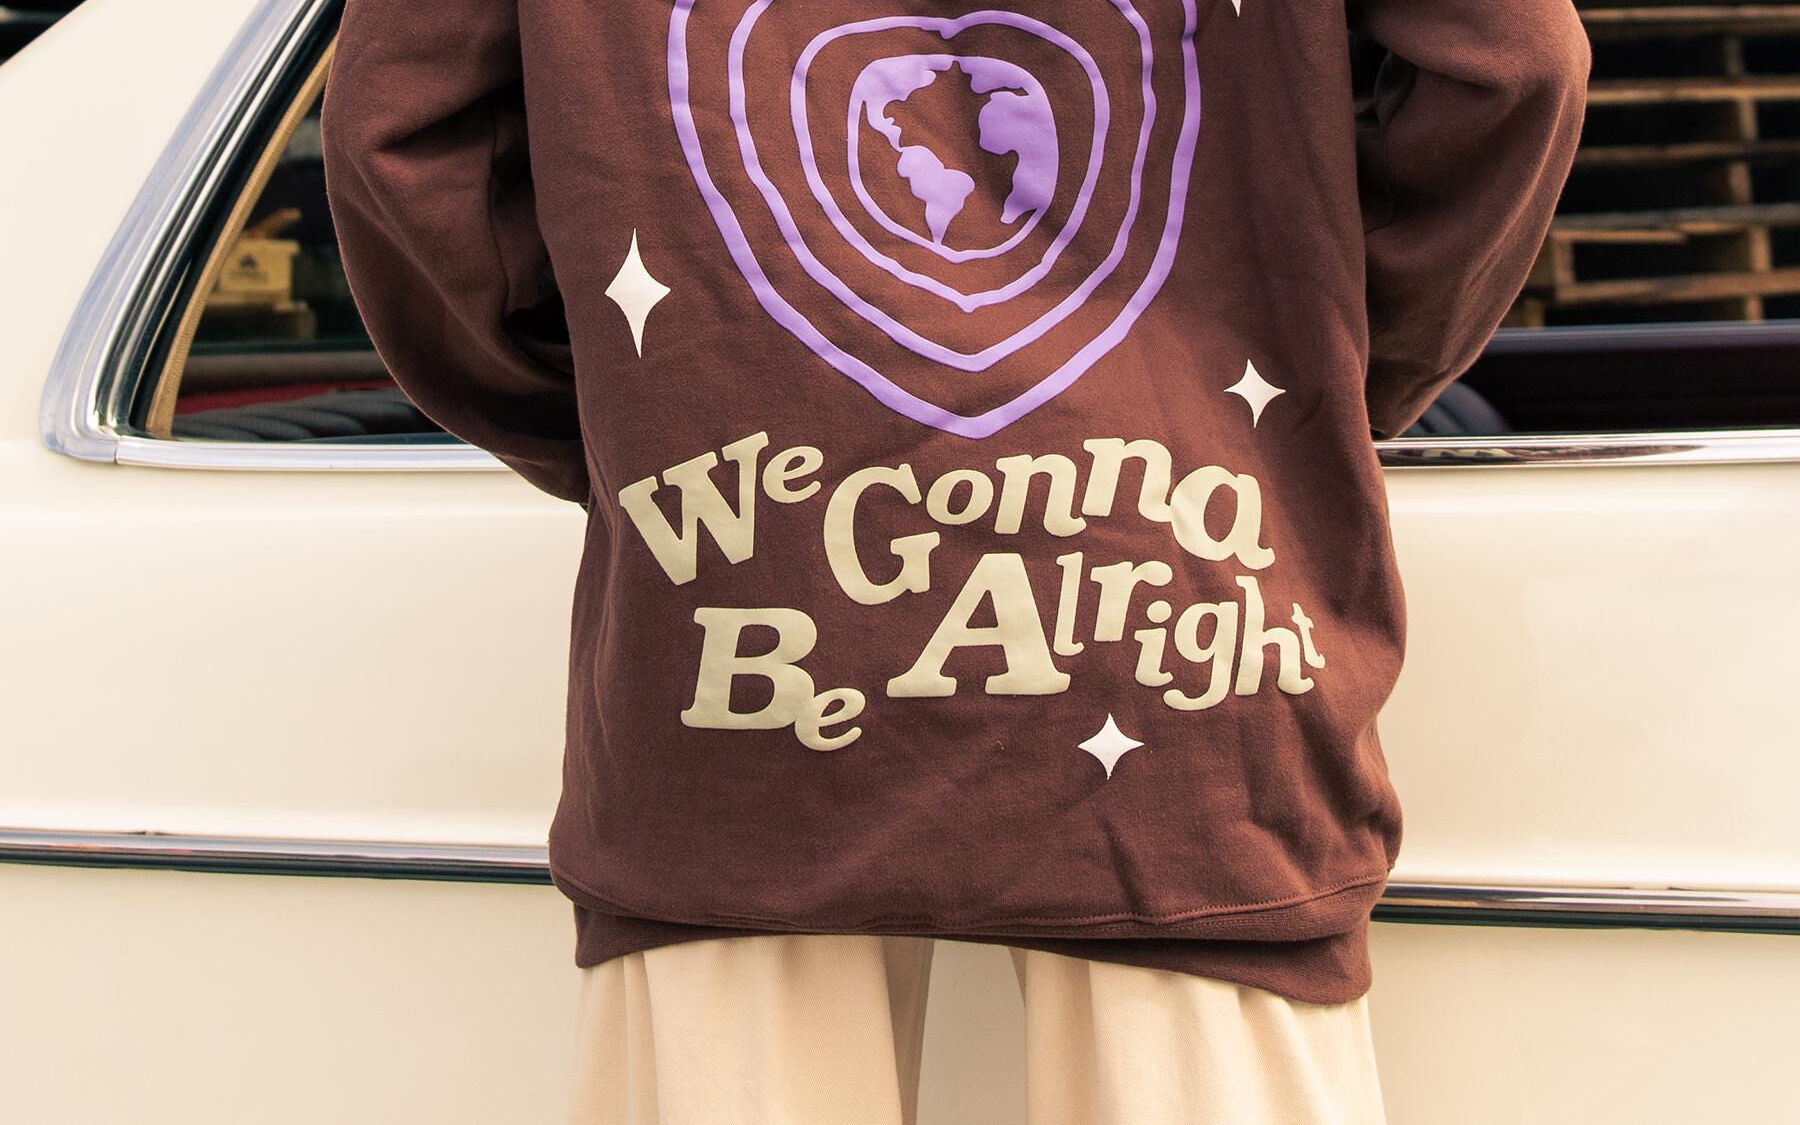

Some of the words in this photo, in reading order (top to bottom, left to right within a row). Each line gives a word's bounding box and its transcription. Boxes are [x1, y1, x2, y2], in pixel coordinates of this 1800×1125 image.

[618, 430, 824, 585] We
[823, 437, 1276, 606] Gonna
[680, 606, 866, 751] Be
[886, 551, 1326, 712] Alright
